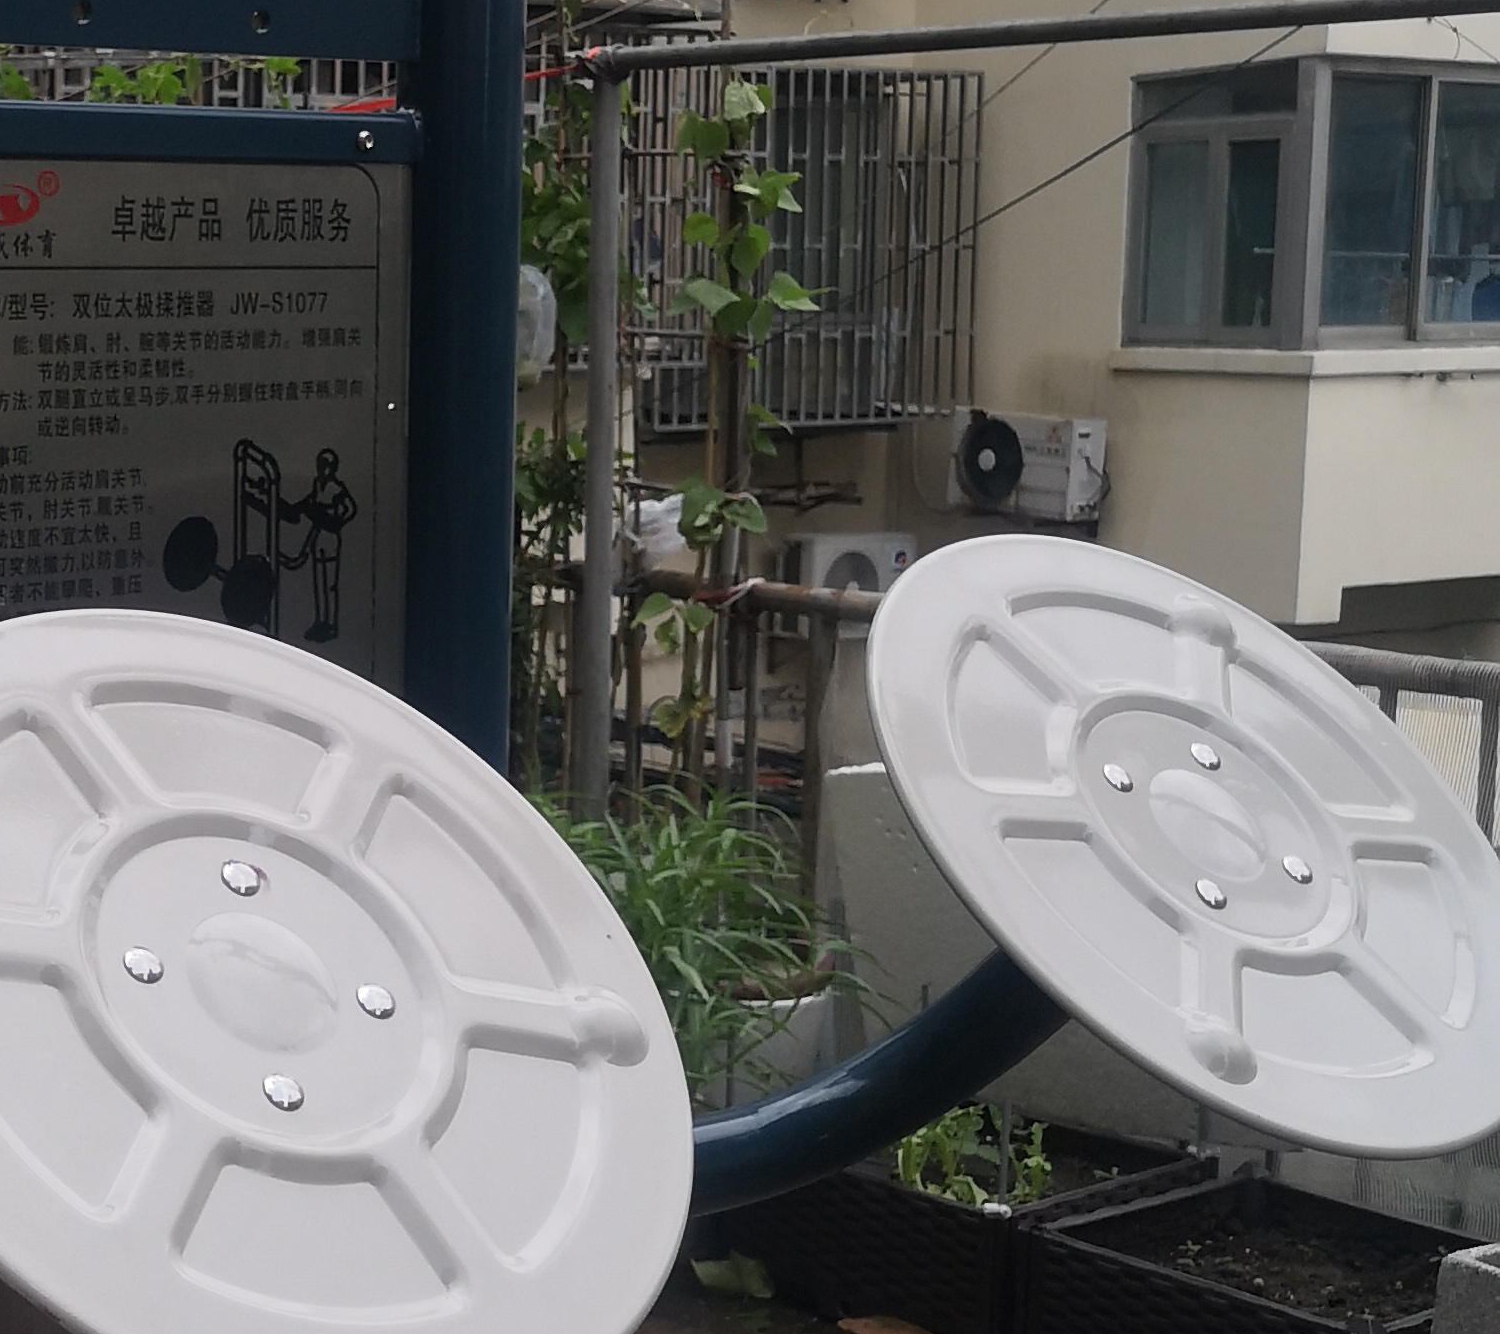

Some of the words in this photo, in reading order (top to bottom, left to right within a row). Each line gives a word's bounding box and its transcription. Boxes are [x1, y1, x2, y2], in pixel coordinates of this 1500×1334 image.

[111, 195, 223, 243] 卓越产品
[246, 197, 352, 244] 优质服务
[230, 291, 329, 315] JW-S1077
